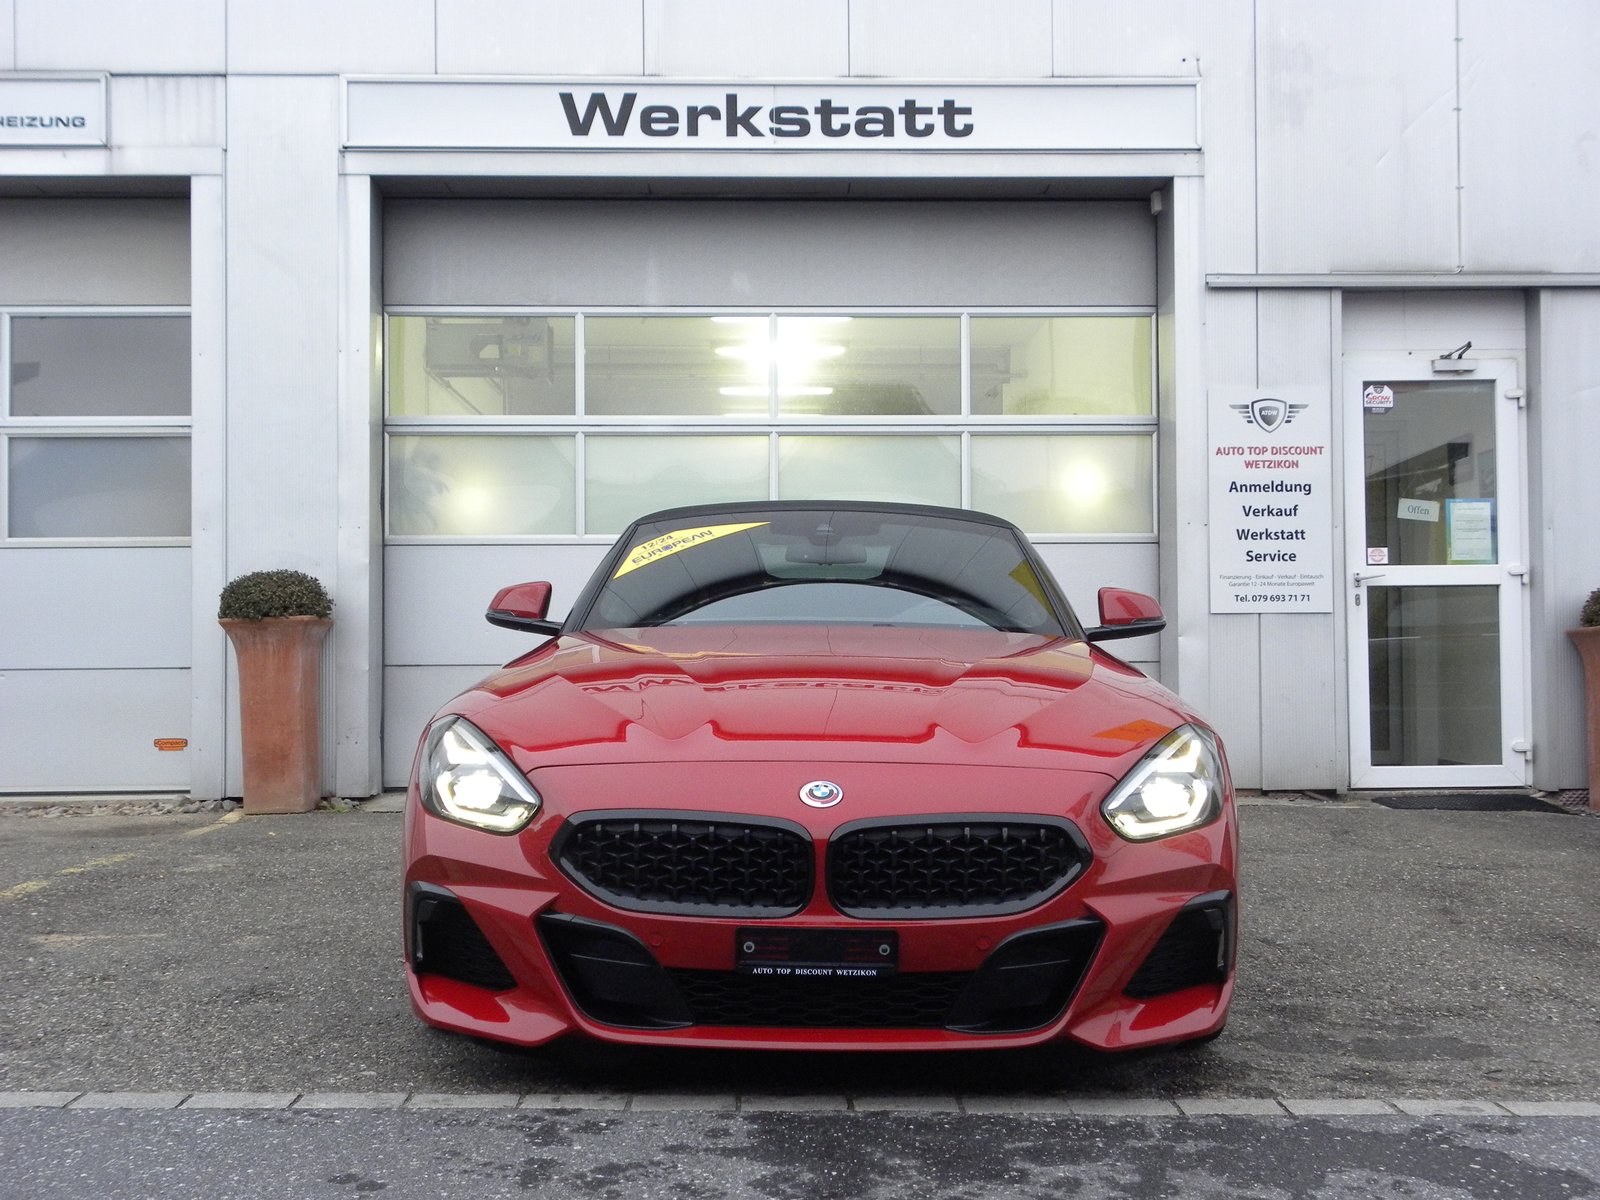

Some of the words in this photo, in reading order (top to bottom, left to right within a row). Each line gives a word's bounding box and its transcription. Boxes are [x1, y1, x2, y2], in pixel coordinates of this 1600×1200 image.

[558, 92, 974, 138] Werkstatt
[1216, 446, 1245, 456] AUTO
[1247, 446, 1268, 456] TOP
[1271, 446, 1324, 456] DISCOUNT
[1244, 459, 1299, 469] WETZIKON
[1229, 480, 1312, 496] Anmeldung
[1242, 504, 1299, 517] Verkauf
[1407, 504, 1430, 515] Offen
[1236, 528, 1306, 541] Werkstatt
[642, 535, 673, 550] 12/24
[1246, 550, 1297, 562] Service
[1234, 594, 1251, 602] Tel.
[1251, 594, 1268, 602] 079
[1269, 594, 1286, 602] 693
[1287, 594, 1298, 602] 71
[1300, 594, 1311, 602] 71
[752, 967, 773, 975] AUTO
[795, 968, 833, 976] DISCOUNT
